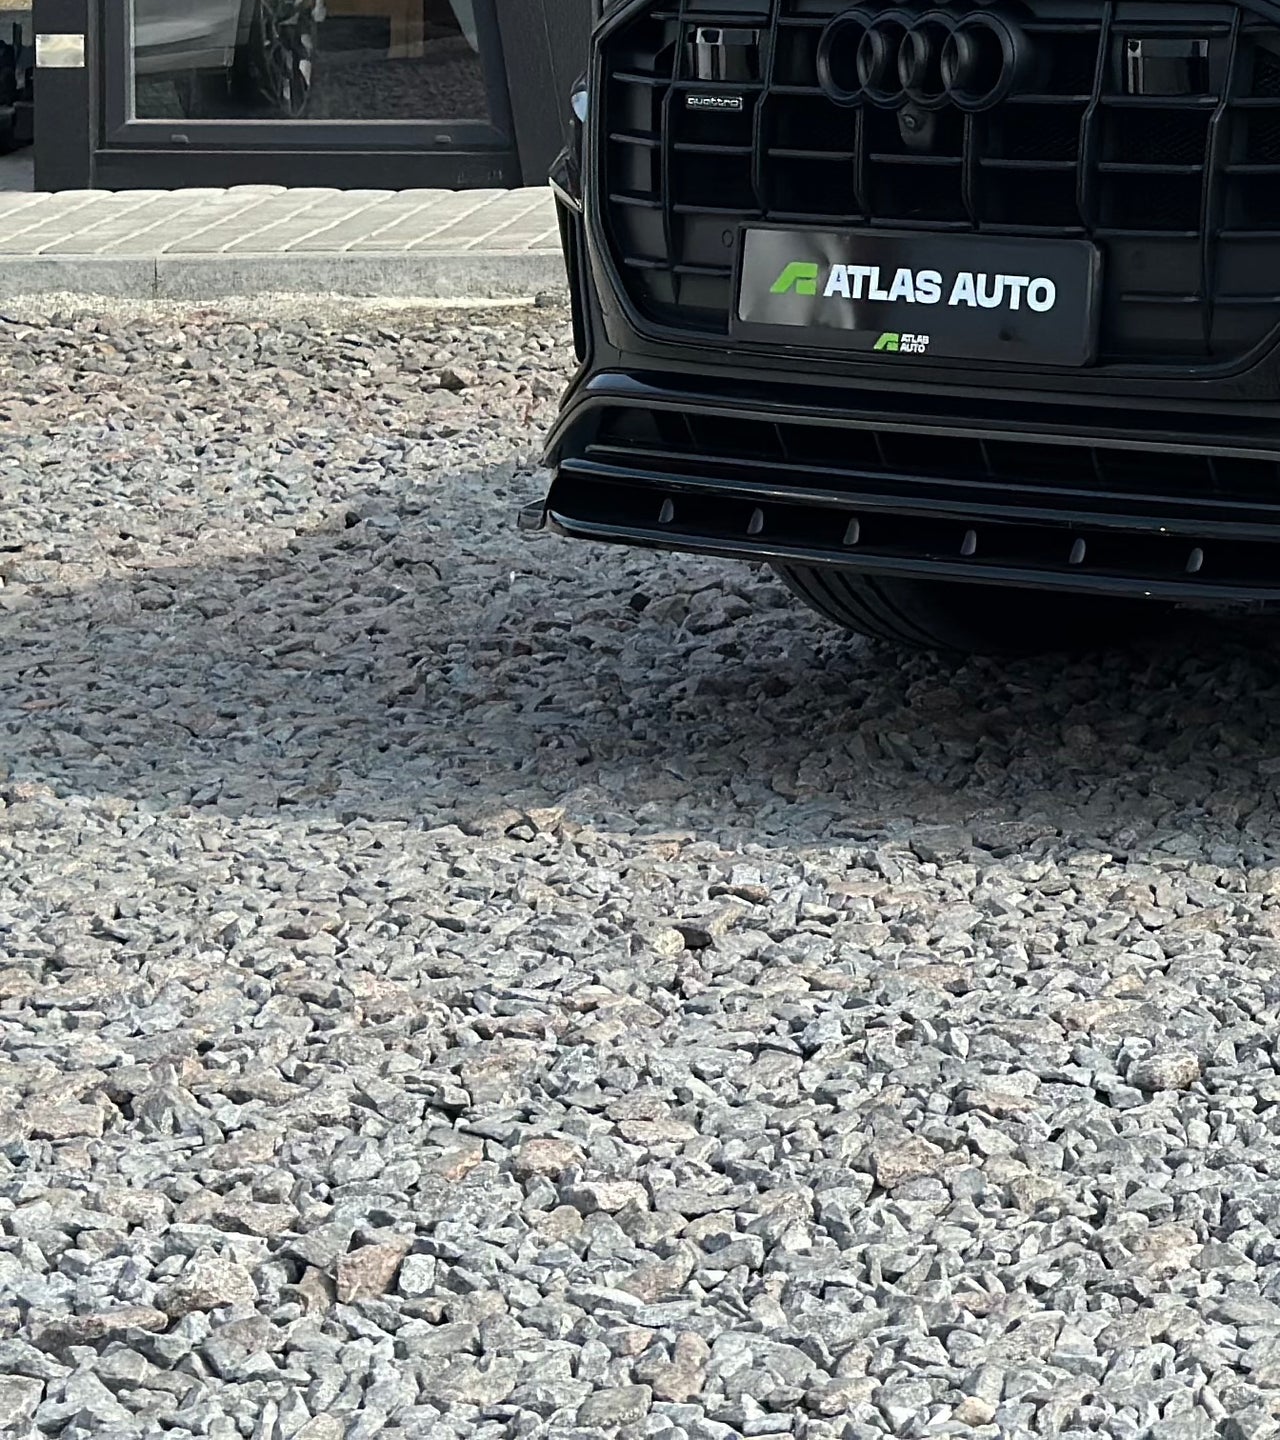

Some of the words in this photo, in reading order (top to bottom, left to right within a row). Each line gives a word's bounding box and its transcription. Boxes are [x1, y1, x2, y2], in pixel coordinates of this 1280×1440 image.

[823, 264, 943, 304] ATLAS
[947, 271, 1056, 312] AUTO
[900, 343, 926, 354] AUTO
